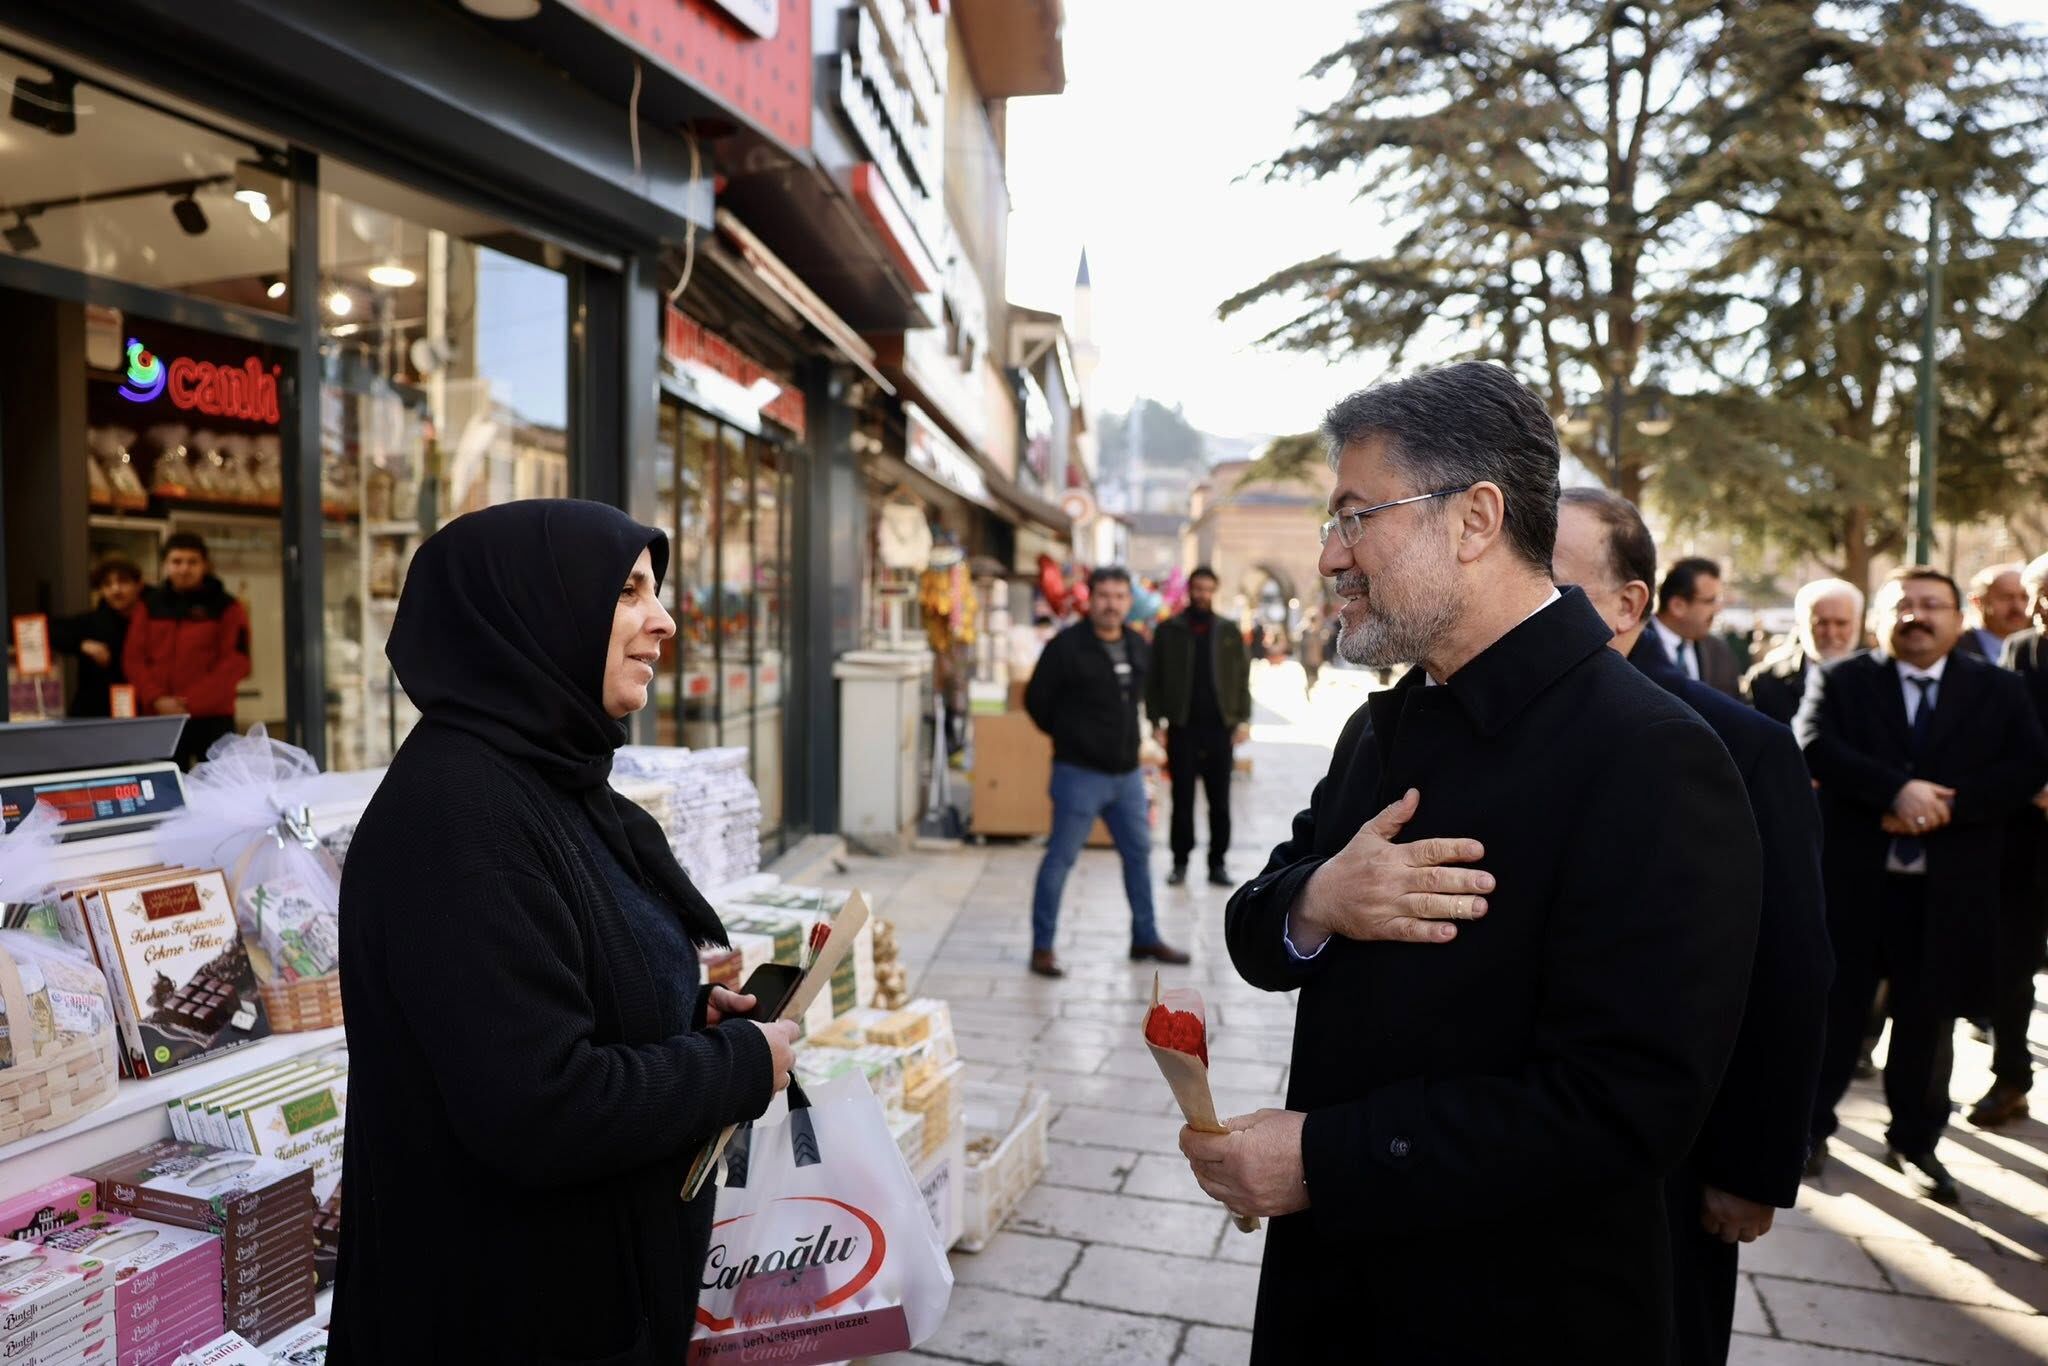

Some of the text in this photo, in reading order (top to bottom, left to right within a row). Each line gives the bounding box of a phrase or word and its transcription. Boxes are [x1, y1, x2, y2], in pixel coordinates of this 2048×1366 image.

[701, 1225, 856, 1290] Canoğlu
[4, 1303, 38, 1330] Bintelli
[743, 1334, 764, 1348] beri
[835, 1315, 870, 1330] lezzet
[4, 1330, 38, 1358] Bintelli
